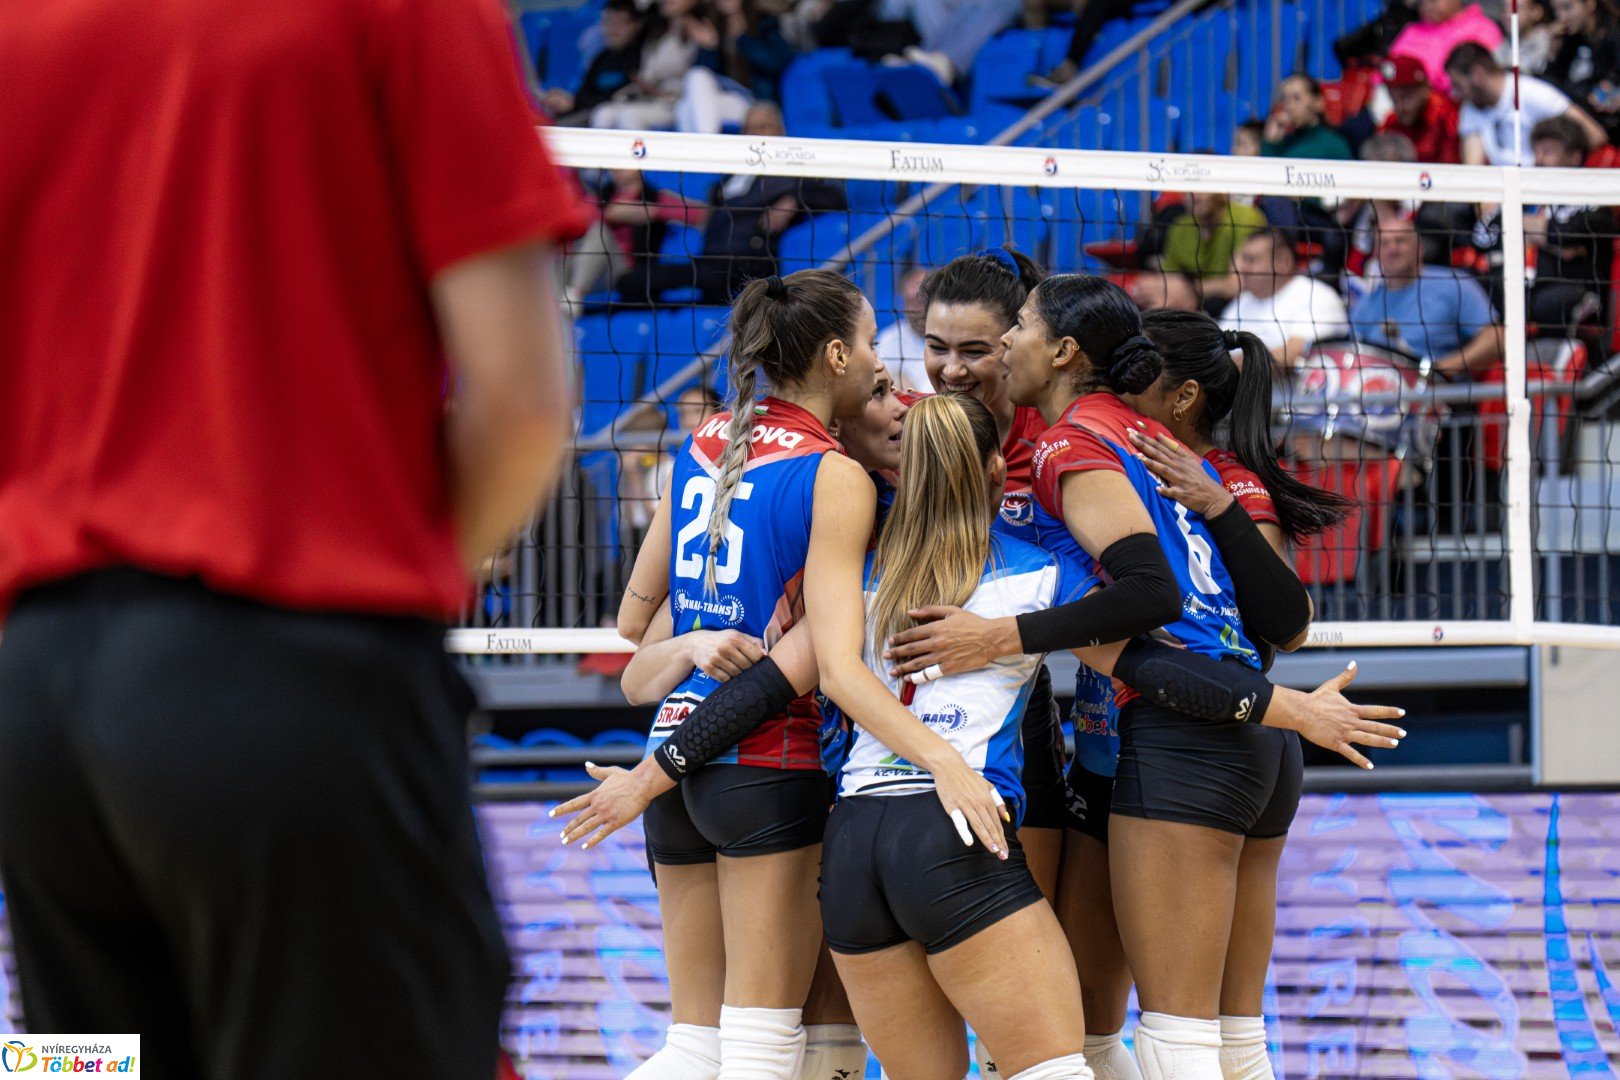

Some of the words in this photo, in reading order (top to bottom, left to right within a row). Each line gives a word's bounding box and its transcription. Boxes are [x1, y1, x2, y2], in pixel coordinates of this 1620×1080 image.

[889, 149, 944, 171] FATUM
[1230, 480, 1255, 492] 99.4
[1232, 486, 1262, 497] NSHINE
[675, 475, 754, 585] 25
[486, 633, 532, 650] FATUM
[1310, 630, 1343, 643] ATUM
